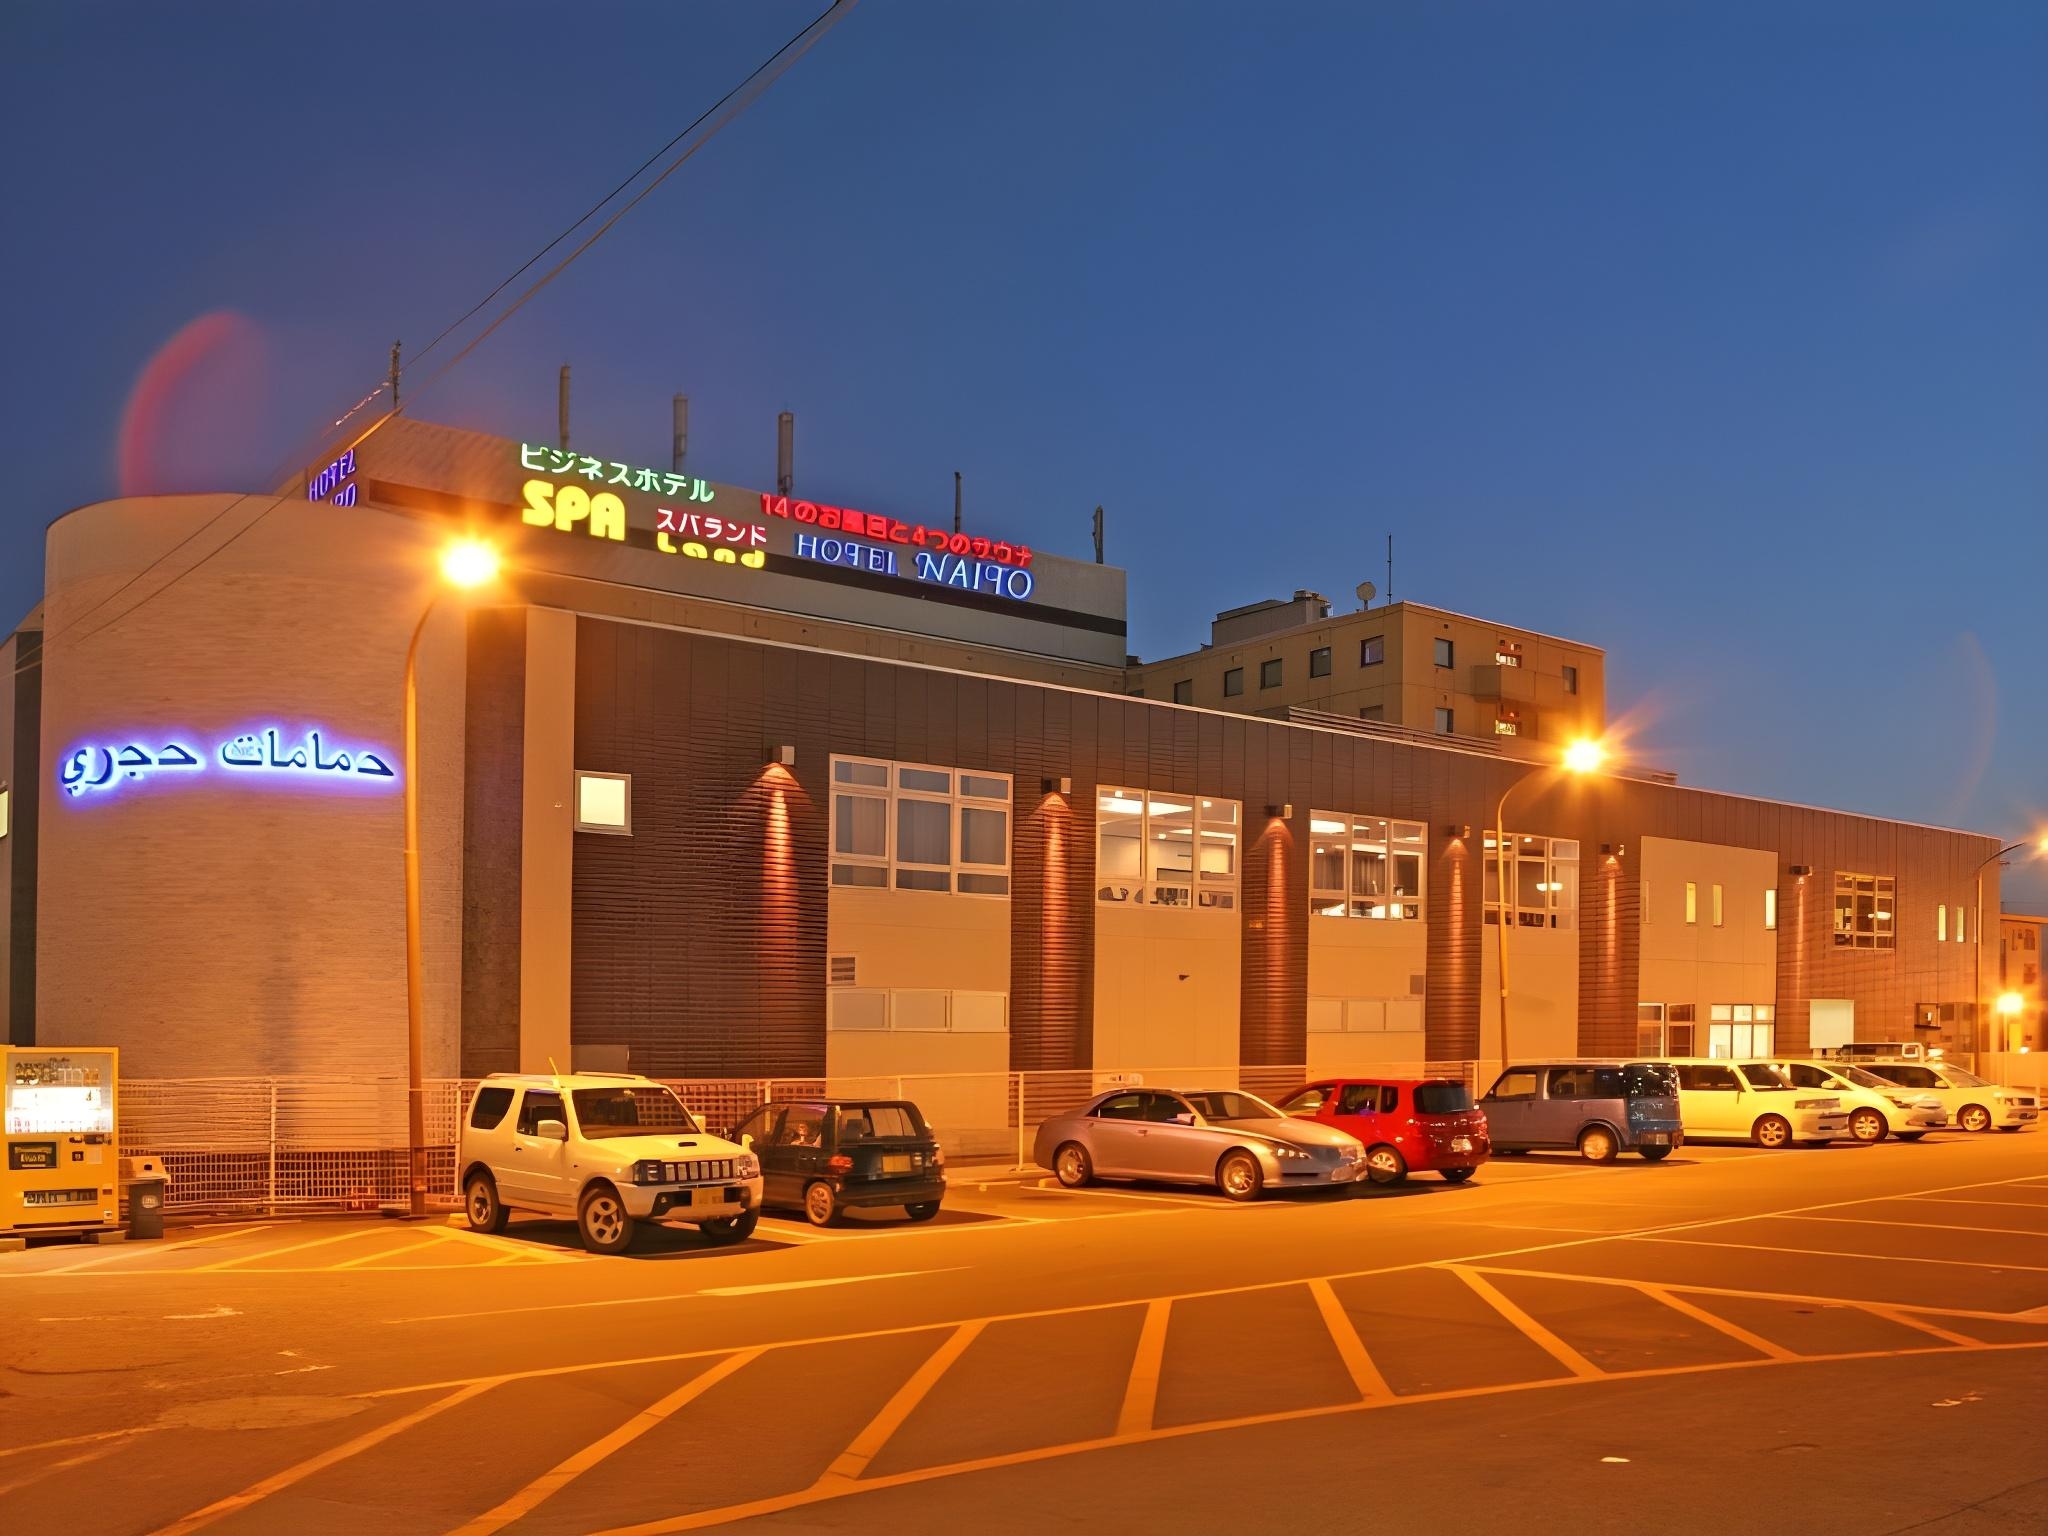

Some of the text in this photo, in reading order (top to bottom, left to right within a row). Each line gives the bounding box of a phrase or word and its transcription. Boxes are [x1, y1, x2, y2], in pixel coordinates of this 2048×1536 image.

[521, 443, 715, 503] ビジネスホテル
[522, 479, 626, 542] SPA
[656, 531, 766, 570] Land
